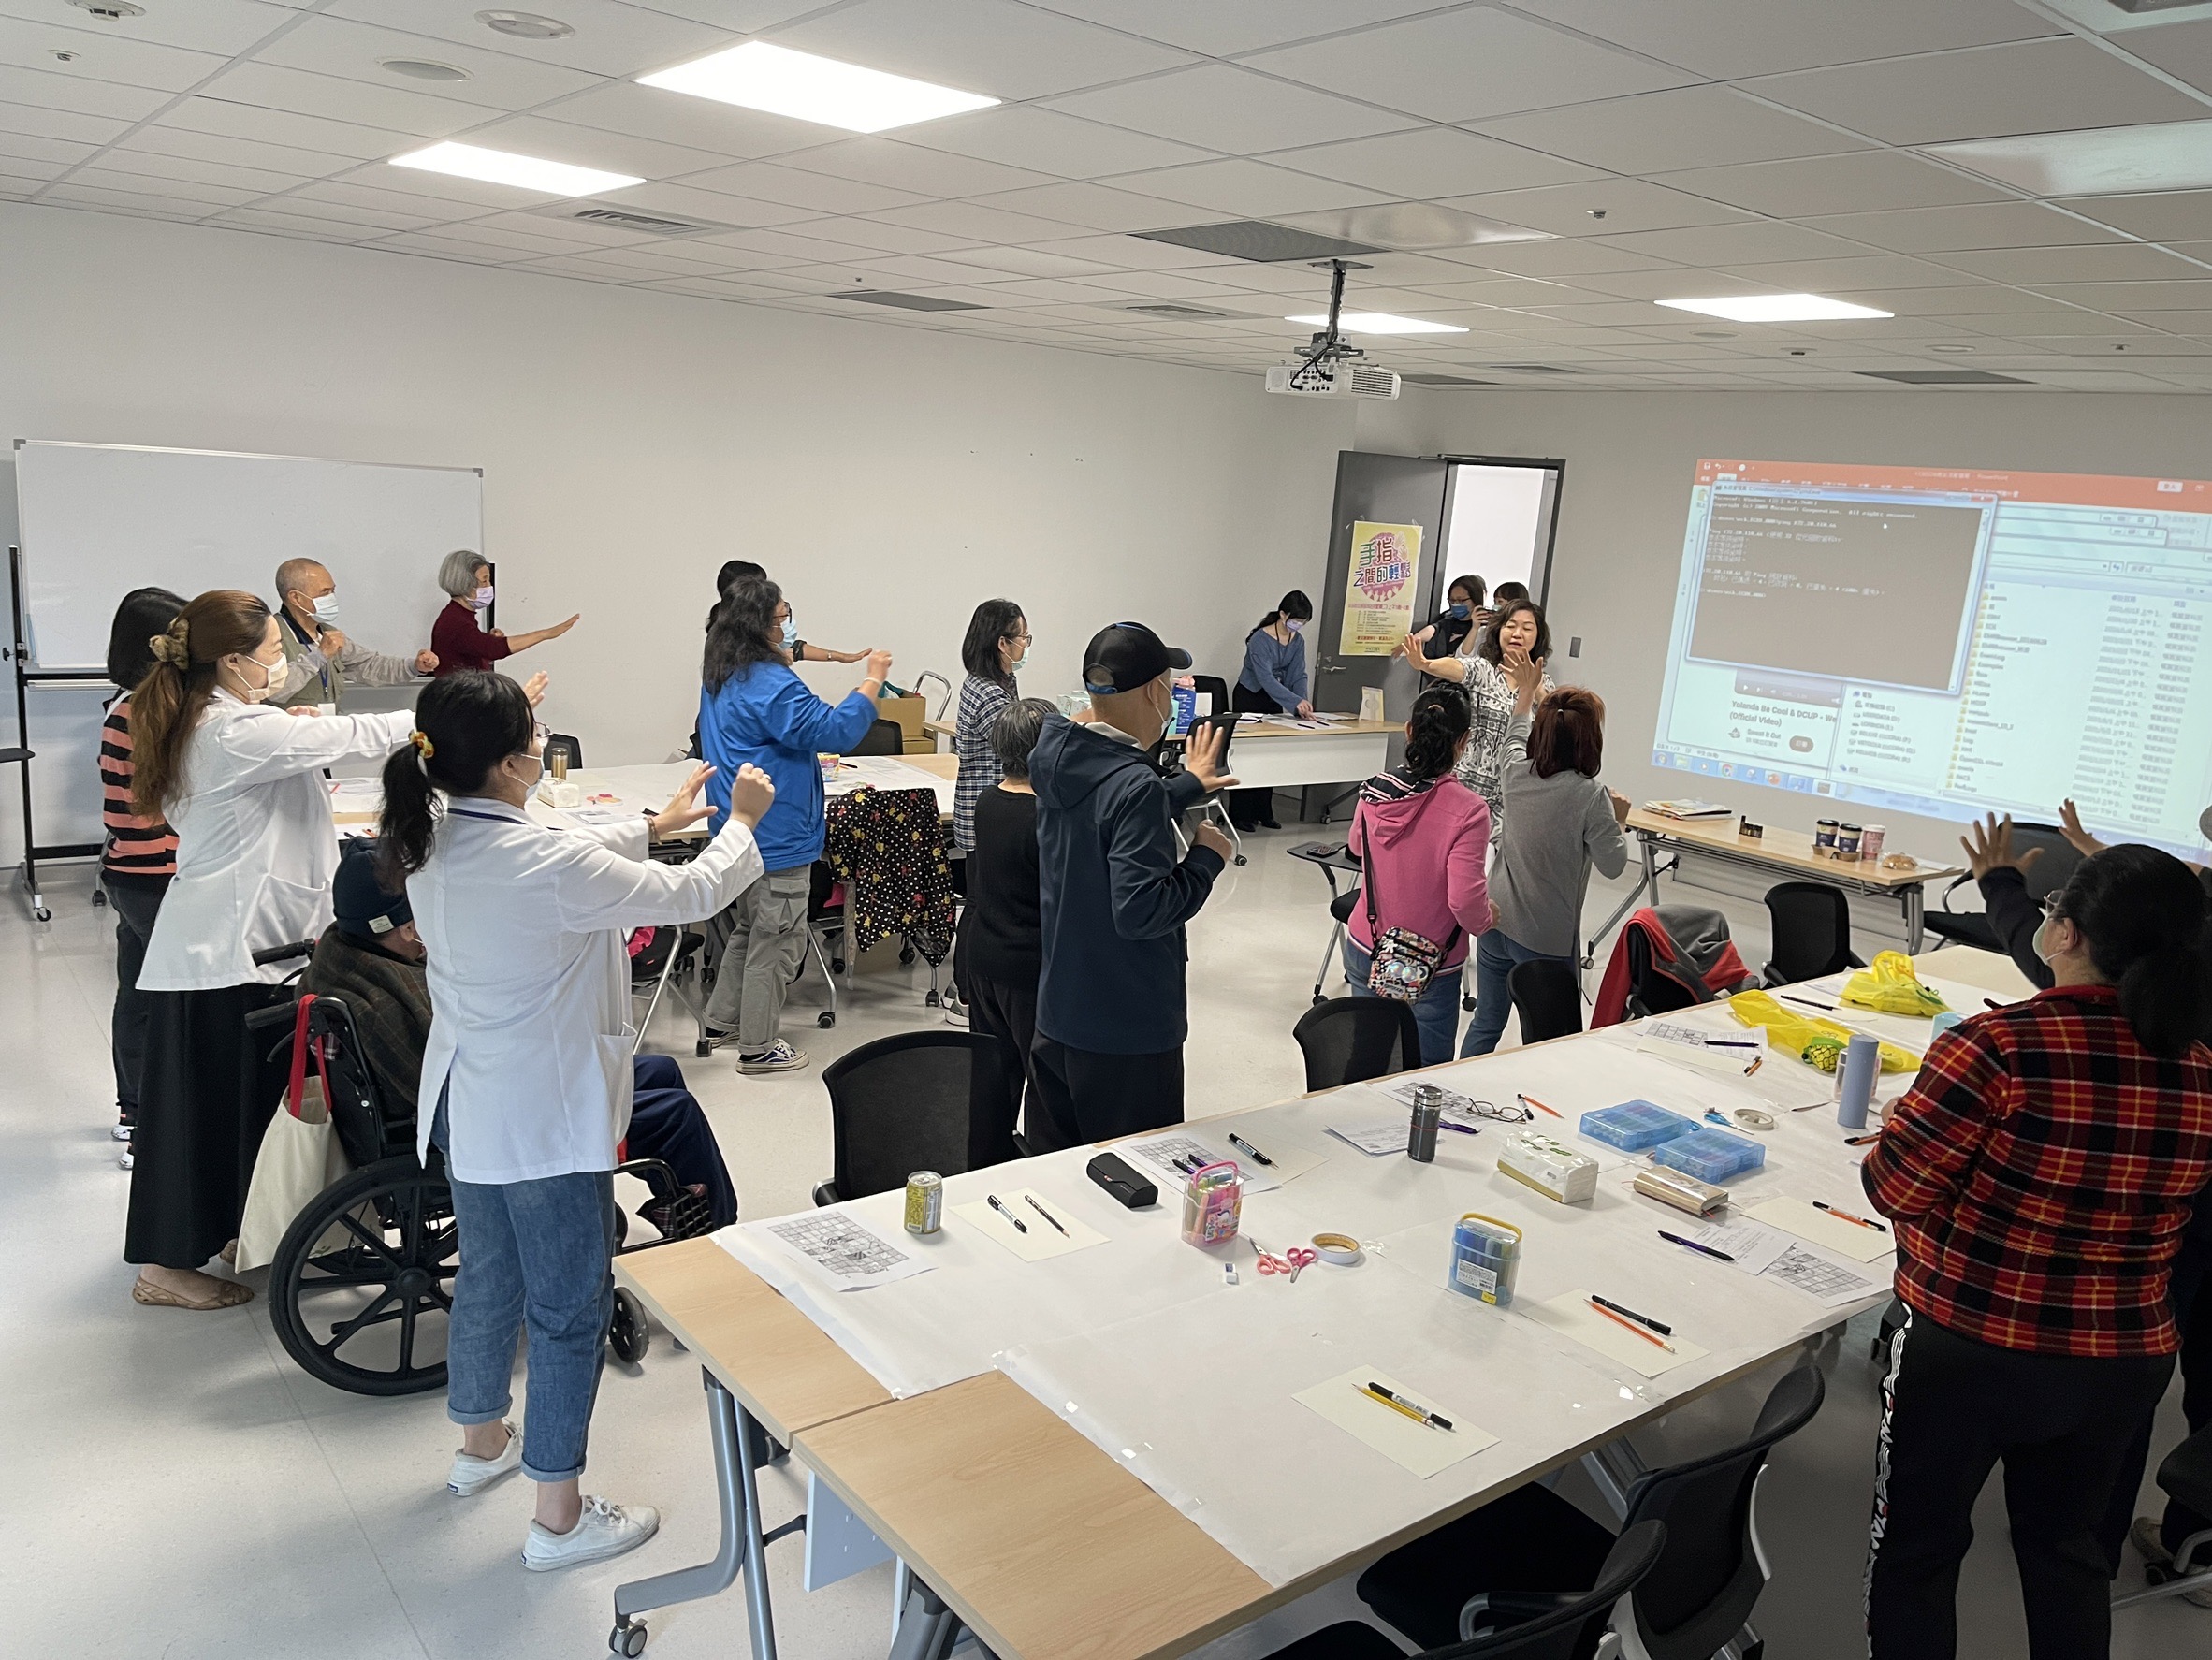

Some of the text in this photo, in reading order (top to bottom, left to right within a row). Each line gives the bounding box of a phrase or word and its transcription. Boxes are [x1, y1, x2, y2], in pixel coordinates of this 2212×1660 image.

[1360, 537, 1392, 567] 手指
[1353, 561, 1411, 587] 之間的輕鬆
[1729, 711, 1783, 727] (Official Video)
[1732, 700, 1760, 711] Yolanda
[1761, 705, 1770, 713] Be
[1772, 706, 1789, 716] Cool
[1797, 710, 1819, 720] DCUP
